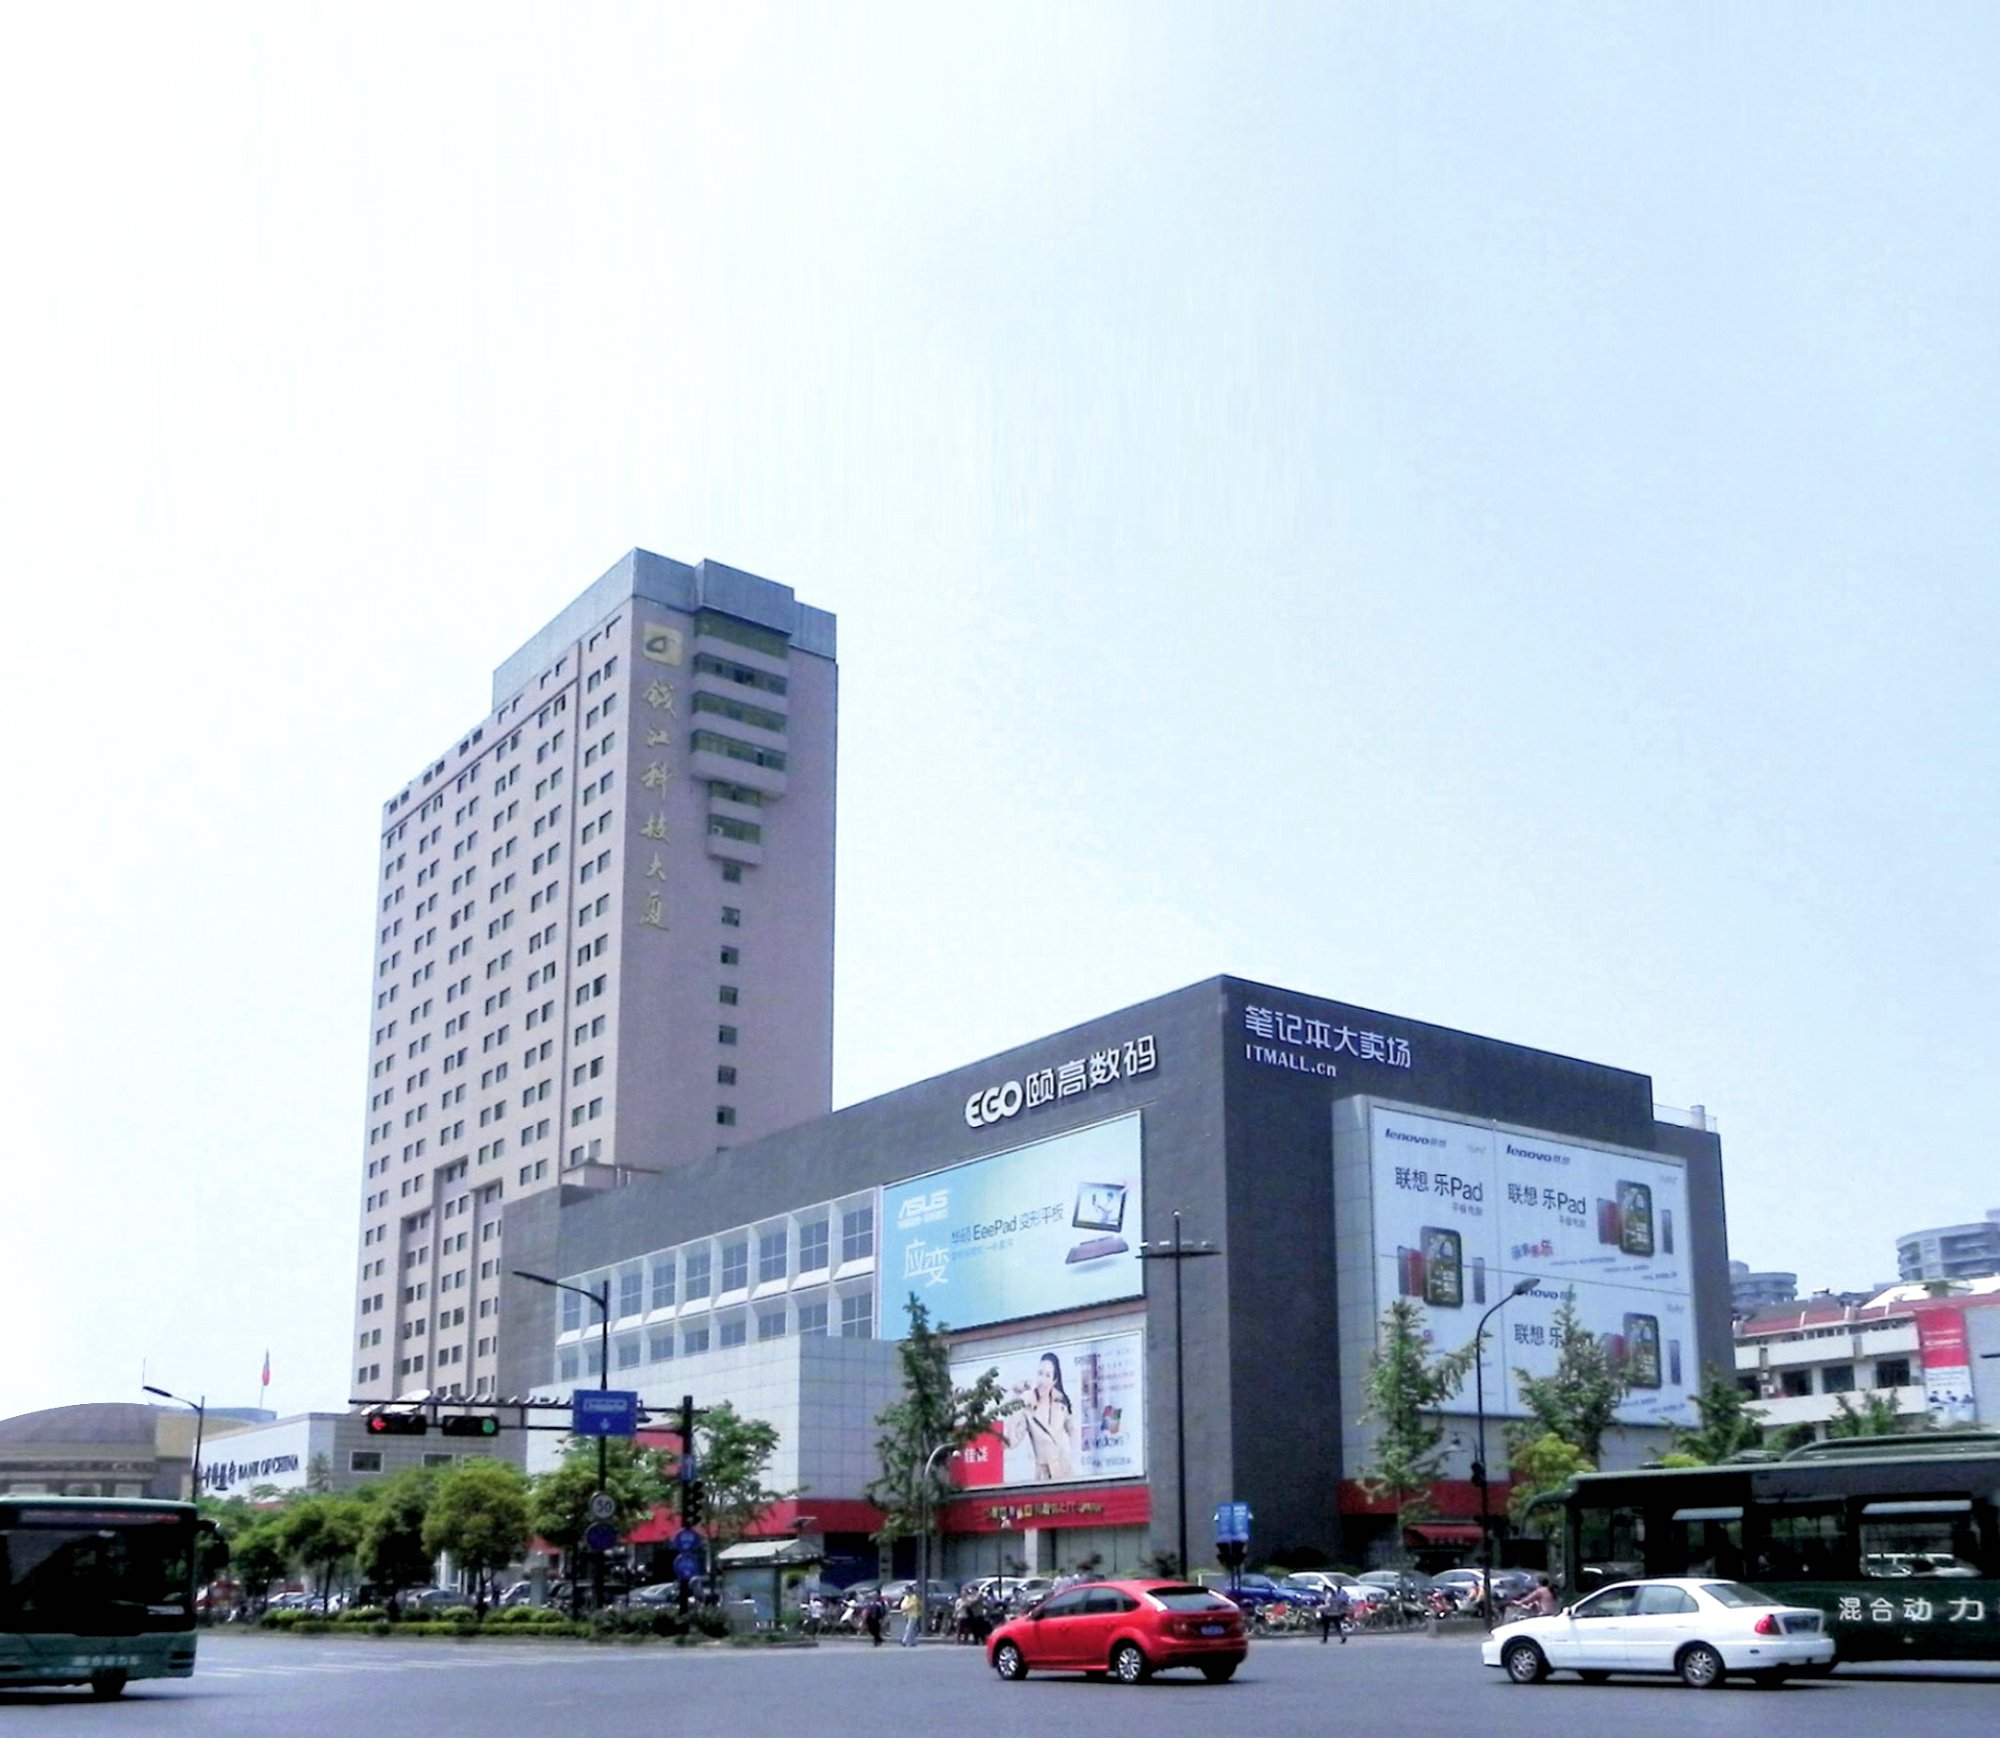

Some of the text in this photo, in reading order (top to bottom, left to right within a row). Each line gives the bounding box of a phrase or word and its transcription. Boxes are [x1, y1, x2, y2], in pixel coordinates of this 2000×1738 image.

[1245, 1004, 1412, 1069] 笔记本大卖场
[1246, 1043, 1337, 1077] ITMALL.cn
[964, 1034, 1157, 1128] EGO 颐高数码
[1385, 1128, 1430, 1146] lenovo
[1506, 1144, 1552, 1164] lenovo
[1395, 1166, 1483, 1202] 联想 乐Pad
[1507, 1182, 1586, 1215] 联想 乐Pad
[898, 1189, 949, 1220] ASUS
[973, 1215, 1017, 1241] EeePad
[904, 1237, 949, 1289] 应变
[1514, 1323, 1545, 1346] 联想
[1838, 1596, 1985, 1622] 混合动力
